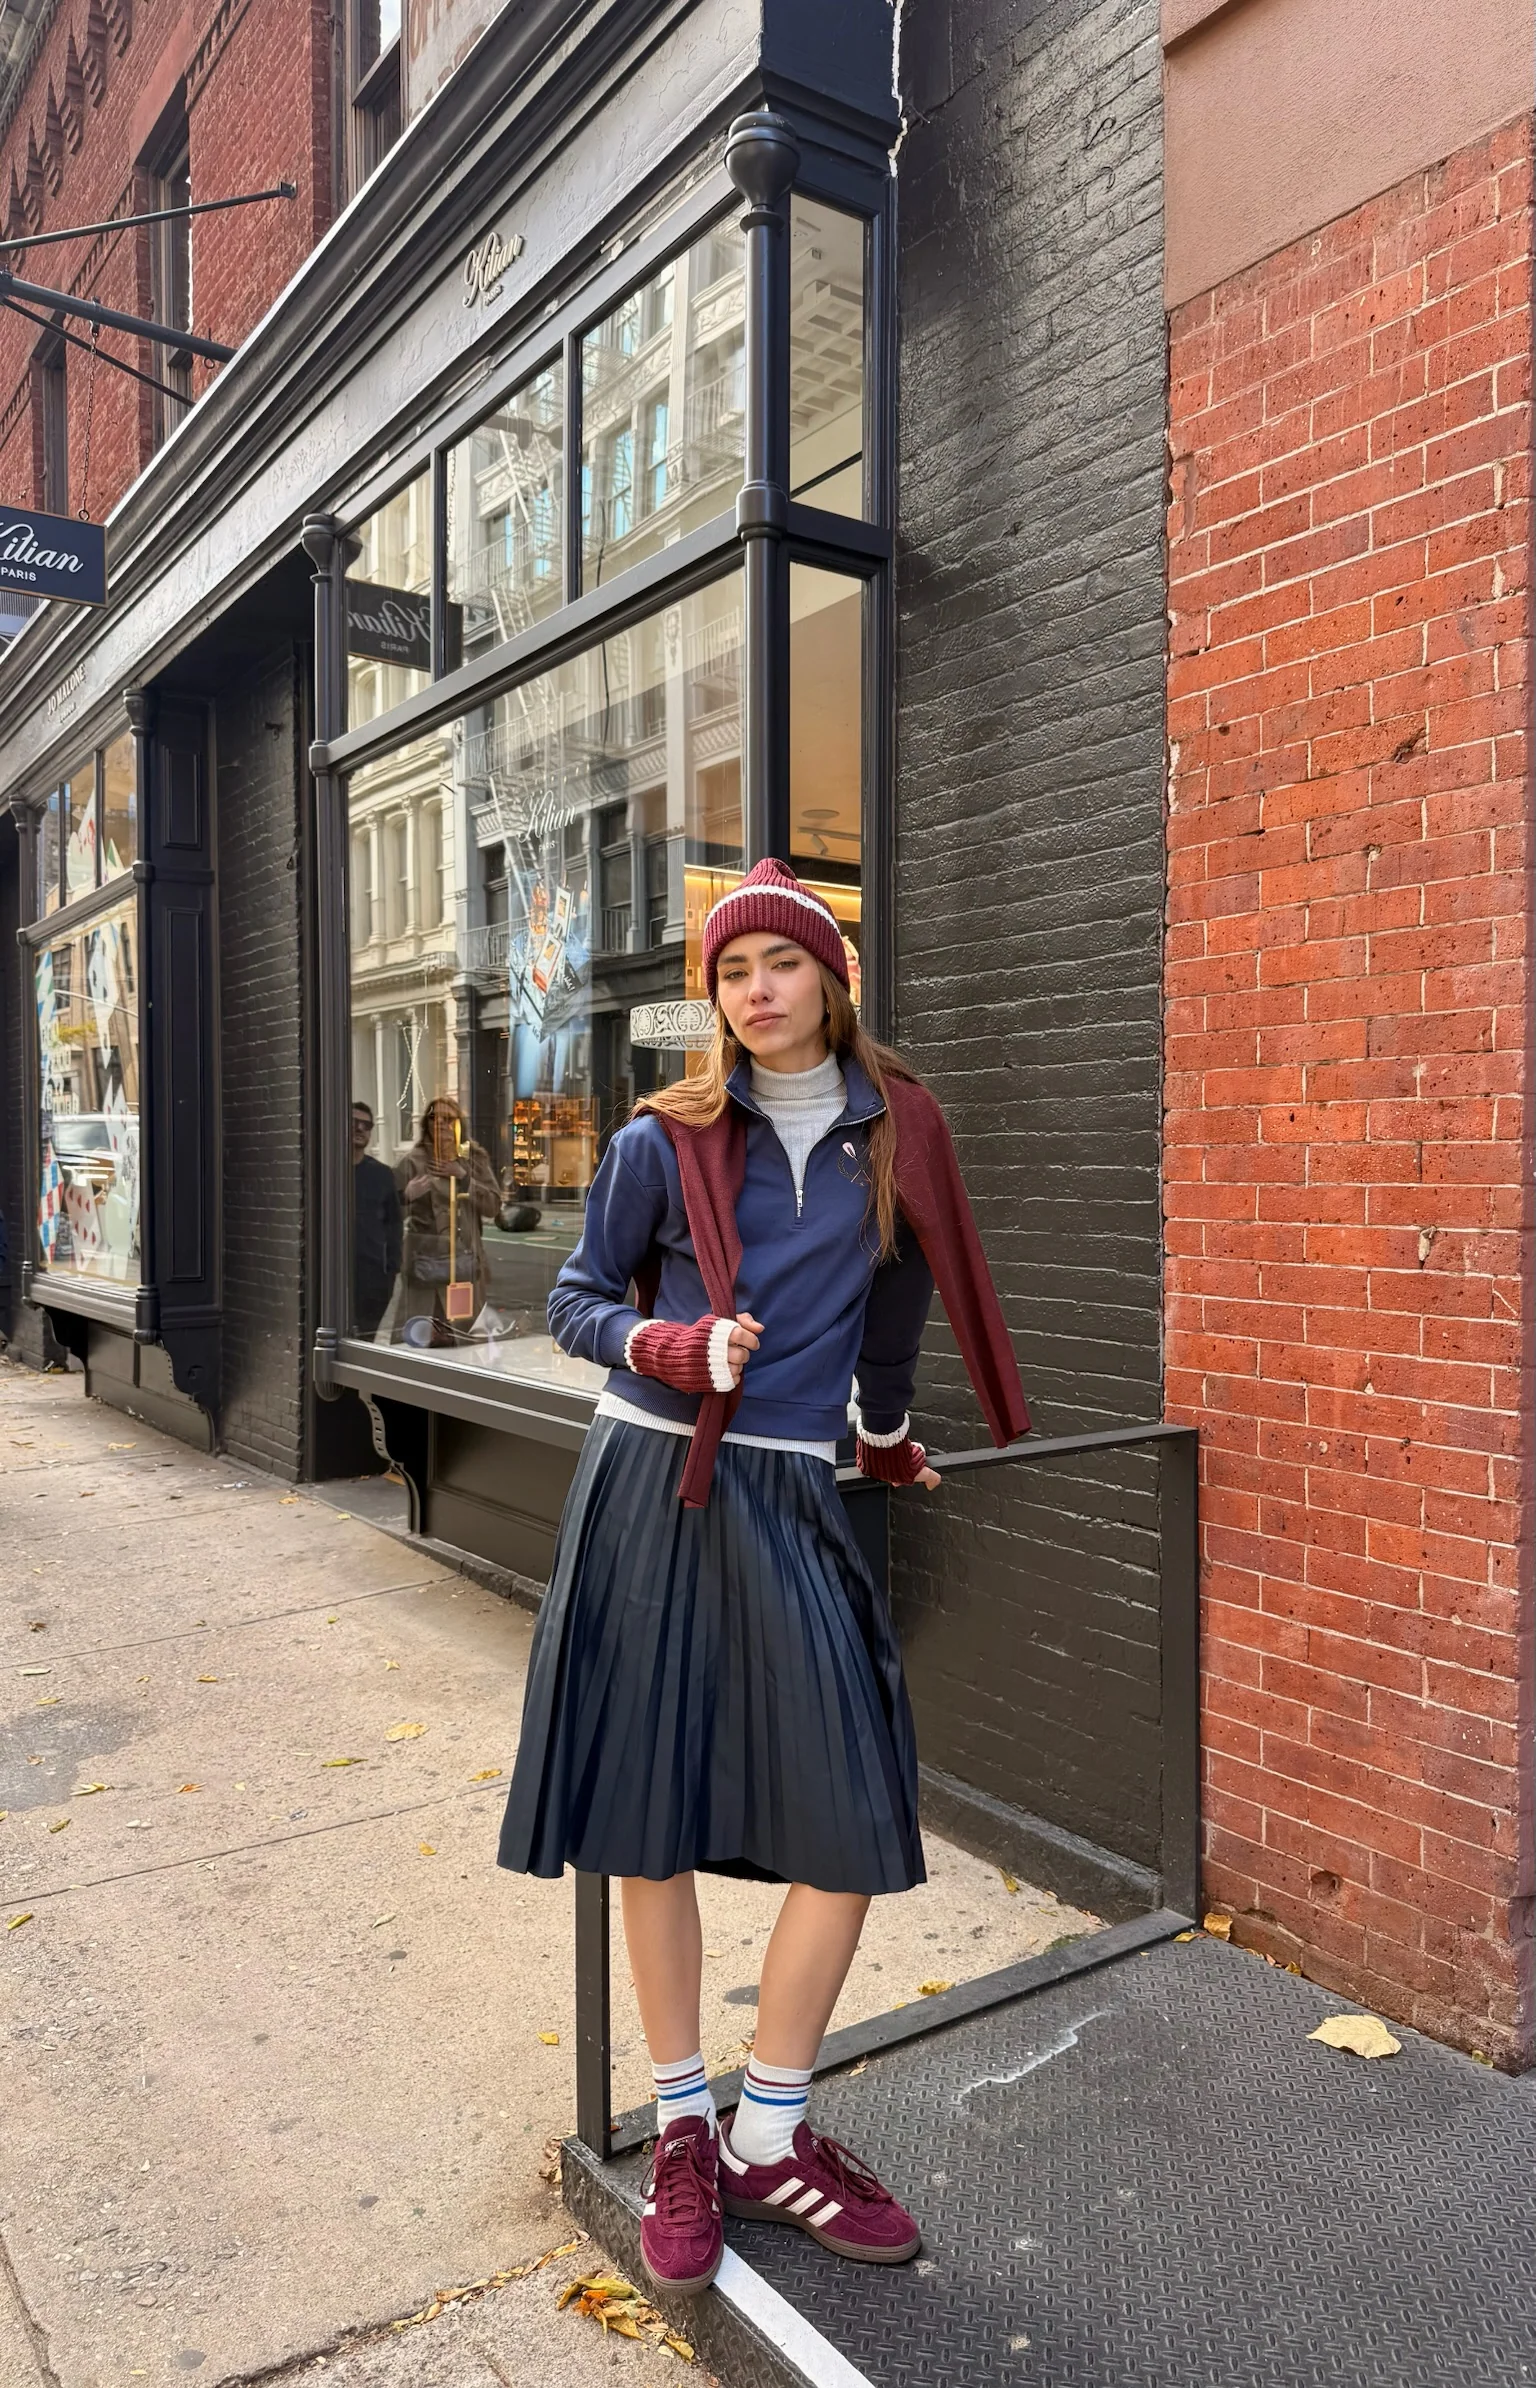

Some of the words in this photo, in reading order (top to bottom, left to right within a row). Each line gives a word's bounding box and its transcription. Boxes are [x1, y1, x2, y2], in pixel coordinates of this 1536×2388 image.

[463, 231, 523, 308] Kilian
[1, 567, 37, 582] PARIS
[47, 696, 57, 716] JO
[57, 663, 86, 705] MALONE
[517, 790, 576, 843] Kilian
